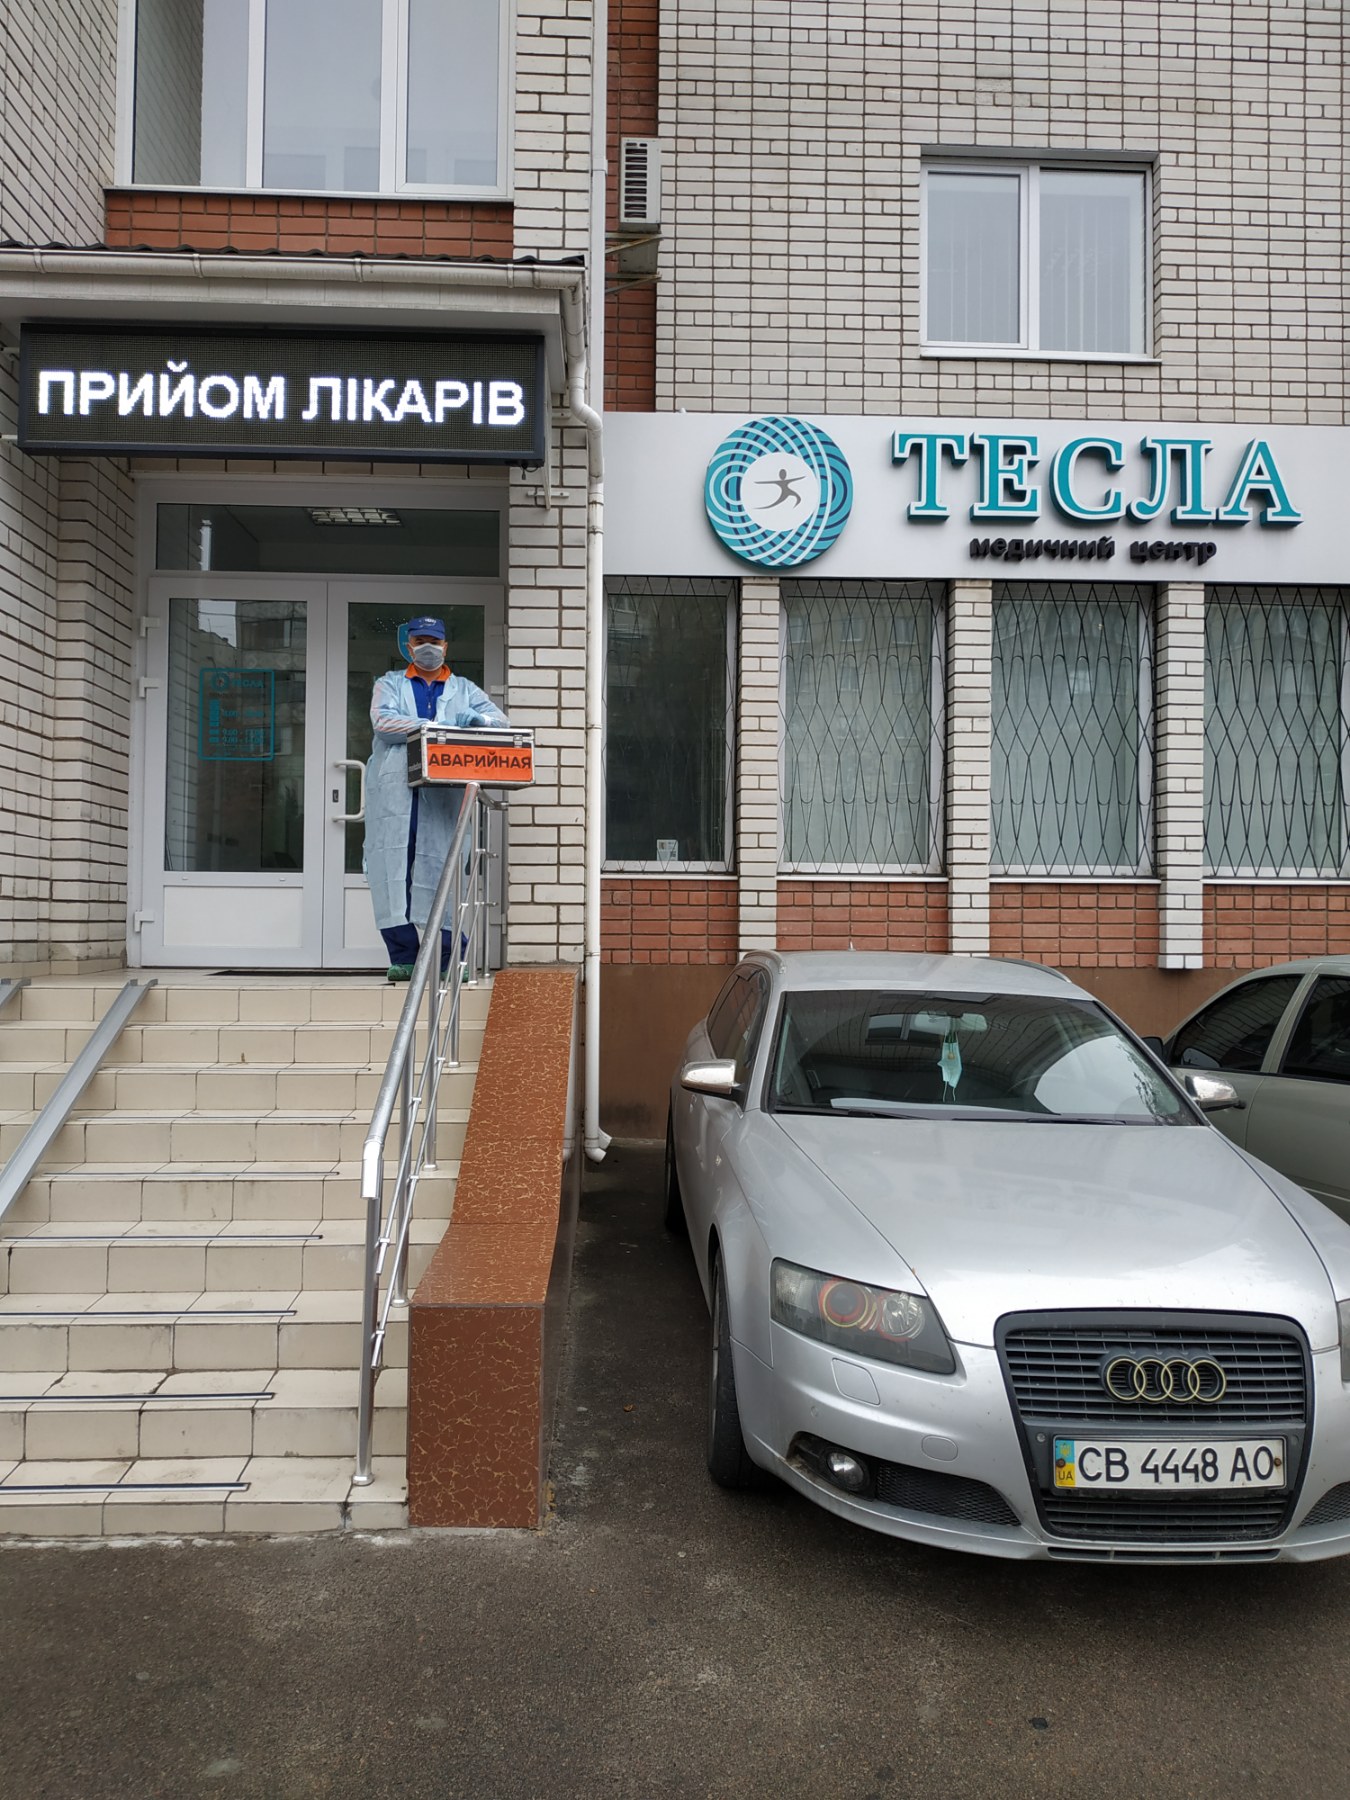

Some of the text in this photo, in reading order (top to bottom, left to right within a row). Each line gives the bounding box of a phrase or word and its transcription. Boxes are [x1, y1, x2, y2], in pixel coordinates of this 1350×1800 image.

[38, 360, 525, 426] ПРИЙОМ ЛІКАРІВ
[892, 432, 1304, 527] ТЕСЛА
[969, 536, 1217, 566] медичний центр
[428, 751, 532, 769] АВАРИЙНАЯ
[1057, 1471, 1074, 1481] UA
[1078, 1446, 1274, 1483] CB 4448 AO
